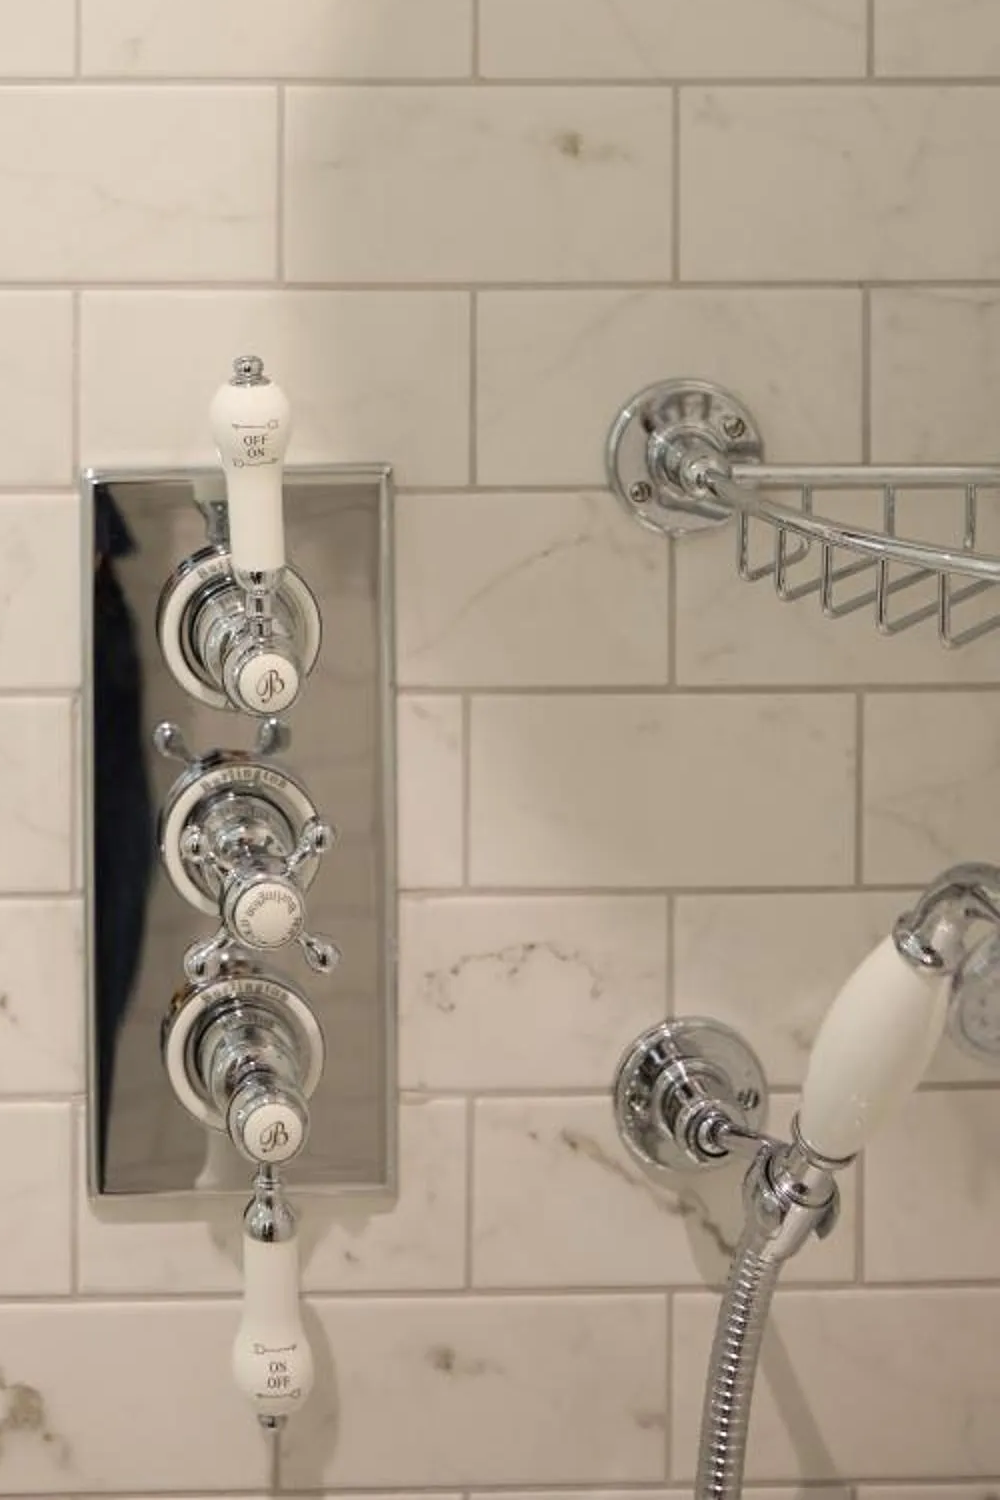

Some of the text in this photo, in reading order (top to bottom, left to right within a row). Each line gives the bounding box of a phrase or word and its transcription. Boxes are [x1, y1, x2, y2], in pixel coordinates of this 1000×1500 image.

[243, 434, 269, 446] OFF
[247, 447, 265, 458] ON
[269, 1361, 287, 1372] ON
[266, 1375, 291, 1389] OFF
